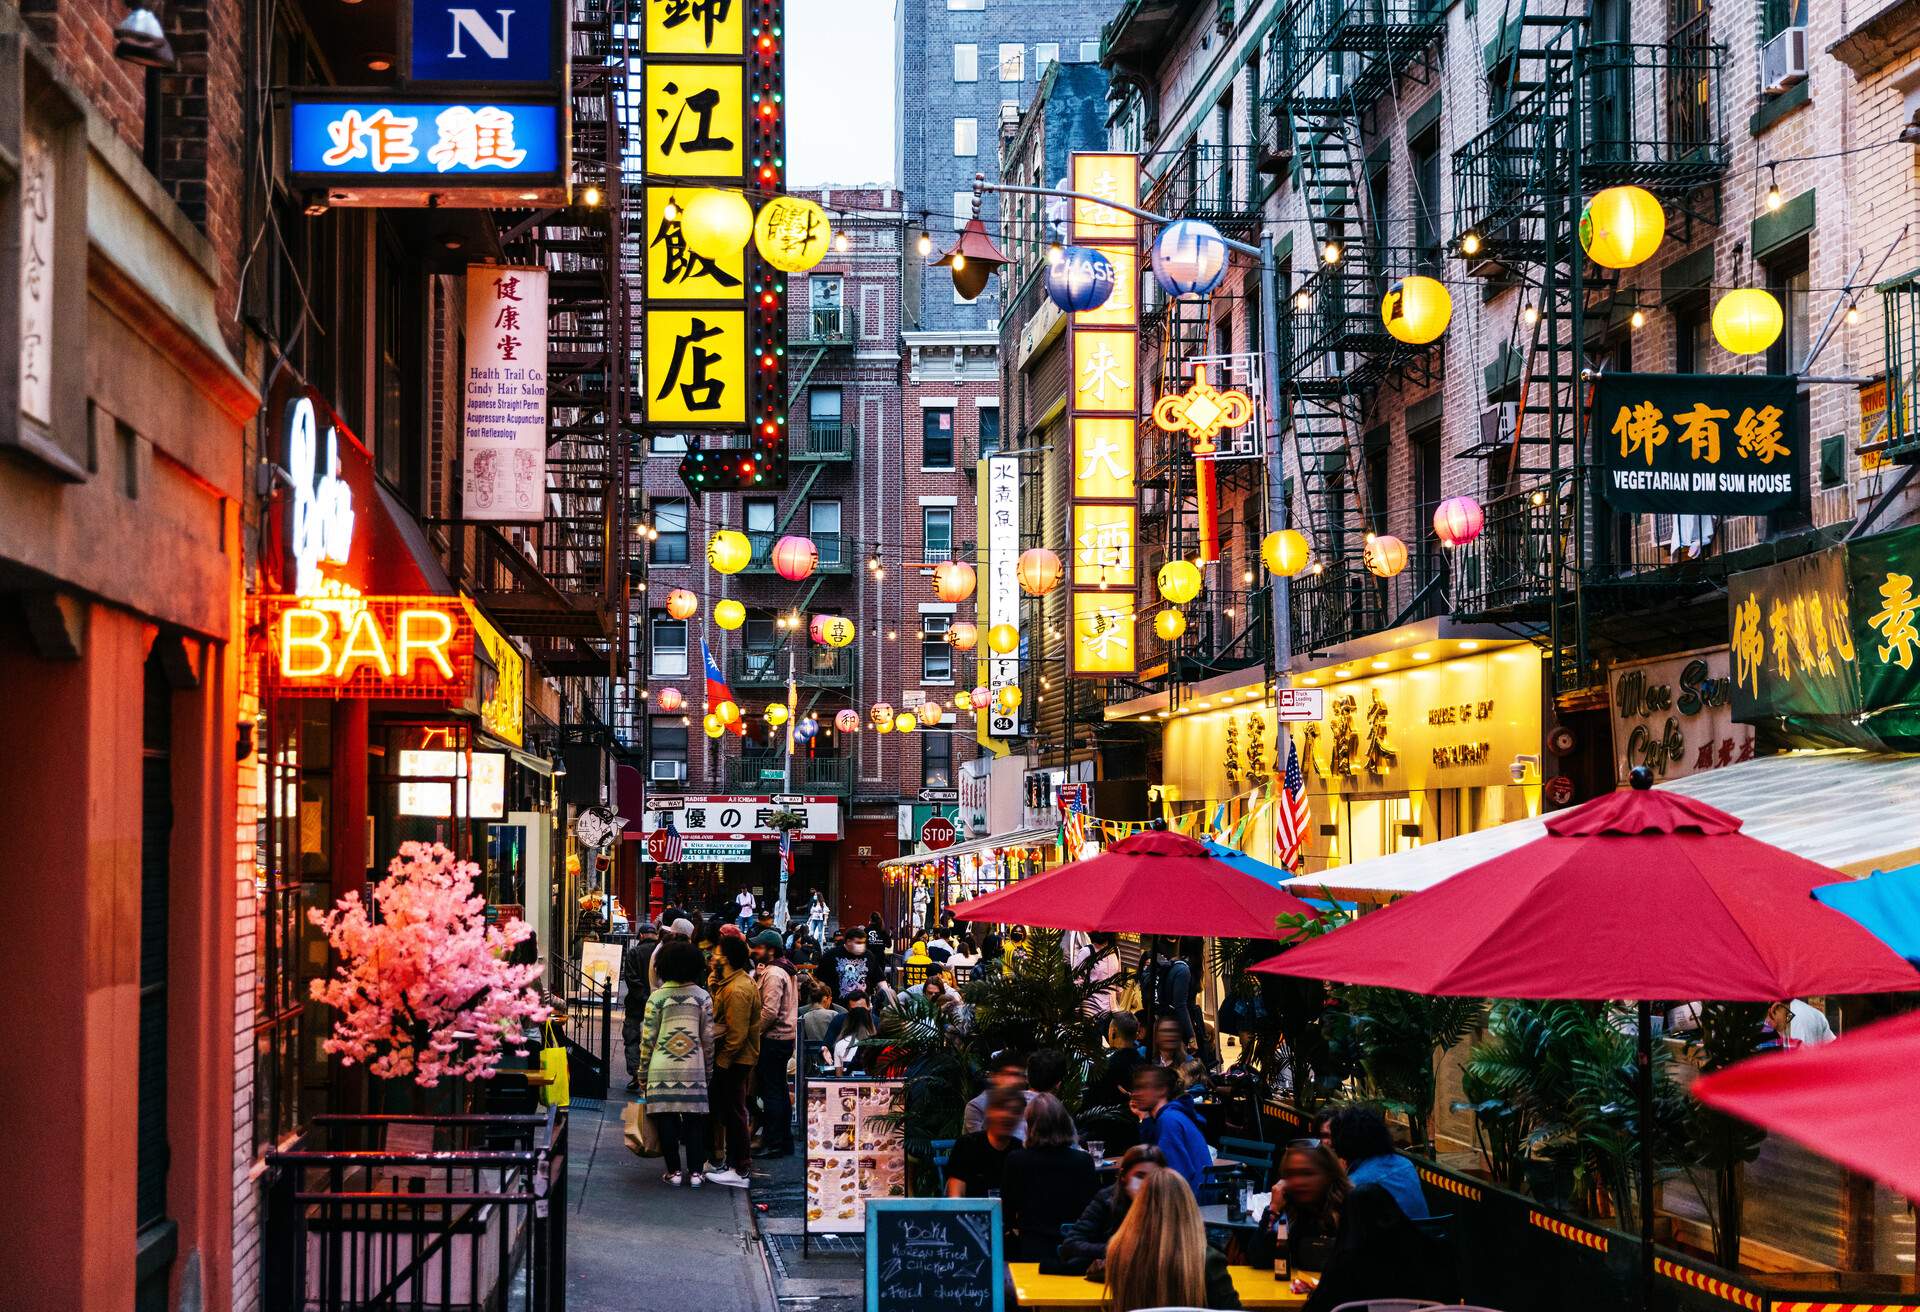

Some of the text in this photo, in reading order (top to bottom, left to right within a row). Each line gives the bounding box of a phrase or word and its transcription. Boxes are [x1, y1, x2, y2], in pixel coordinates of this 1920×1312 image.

[447, 8, 516, 58] N
[322, 106, 527, 172] 炸雞
[493, 276, 523, 361] 健康堂
[470, 367, 544, 381] Health Trail Co.
[467, 382, 545, 398] Cindy Hair Salon
[467, 399, 540, 412] Japanese Straight Perm
[466, 412, 545, 426] Acupressure Acupuncture
[466, 427, 517, 441] Foot Reflexology
[1611, 400, 1792, 467] 佛有緣
[1613, 470, 1792, 493] VEGETARIAN DIM SUM HOUSE
[993, 464, 1015, 527] 水煮魚
[831, 622, 847, 643] 喜
[279, 608, 455, 679] BAR
[842, 713, 856, 726] 和
[996, 718, 1010, 729] 34
[668, 799, 681, 807] WAY
[923, 828, 954, 841] STOP
[649, 840, 664, 853] ST
[859, 847, 870, 856] 37
[936, 1246, 968, 1260] Fried
